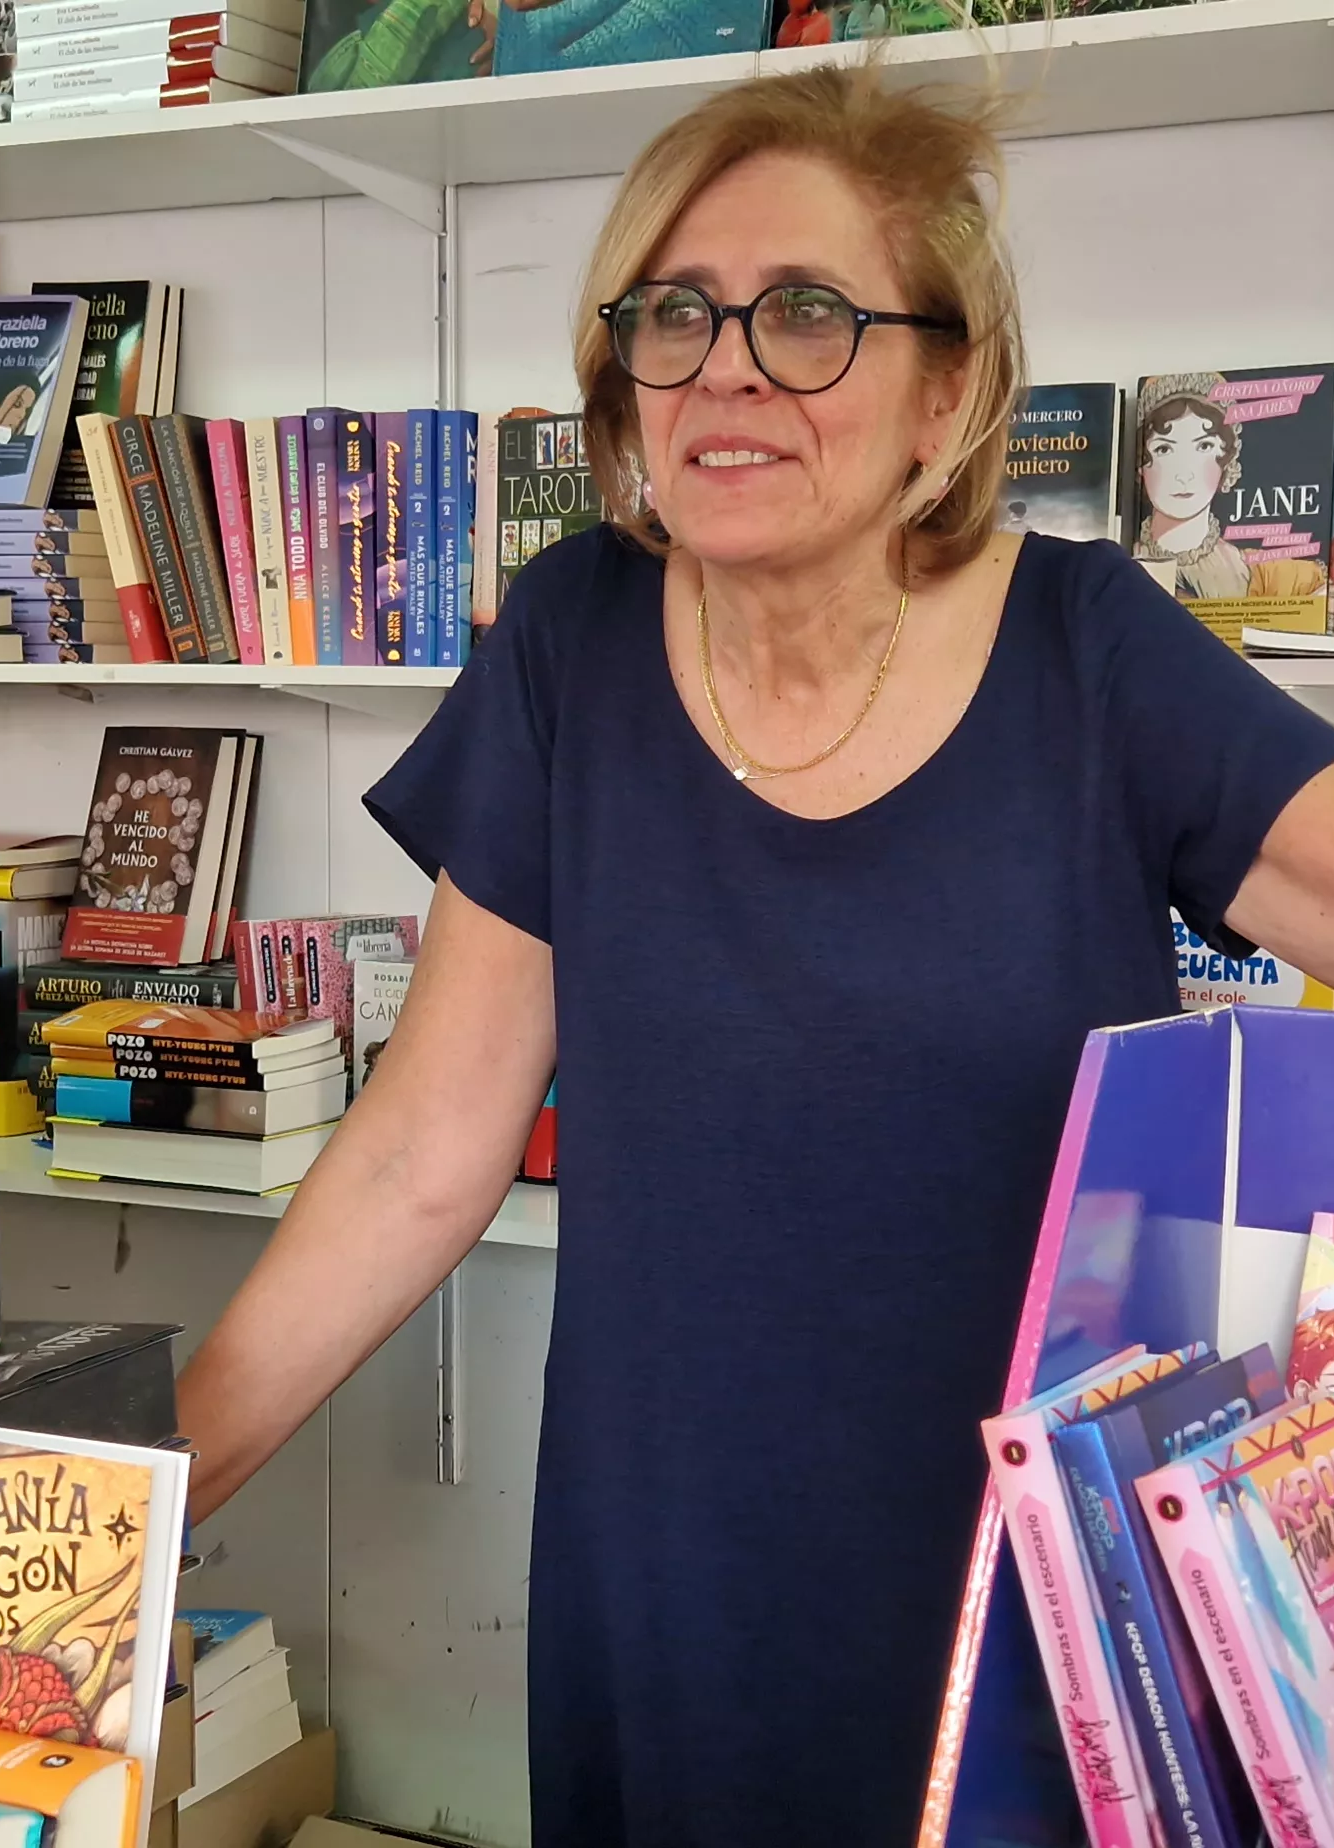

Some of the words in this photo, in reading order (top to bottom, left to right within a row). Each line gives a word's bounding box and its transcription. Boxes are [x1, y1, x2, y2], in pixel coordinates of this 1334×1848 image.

[1021, 409, 1084, 424] MERCERO
[1230, 407, 1256, 420] ANA
[1257, 399, 1295, 418] JARÉN
[504, 431, 526, 460] EL
[1008, 431, 1088, 453] oviendo
[1005, 456, 1070, 479] quiero
[504, 472, 592, 516] TAROT
[1229, 484, 1320, 523] JANE
[123, 426, 145, 474] CIRCE
[137, 483, 170, 566] MADELINE
[160, 570, 185, 626] MILLER
[416, 587, 425, 636] RIVALES
[445, 590, 455, 638] RIVALES
[119, 745, 157, 756] CHRISTIAN
[160, 747, 193, 758] GÁLVEZ
[134, 810, 149, 823] HE
[113, 824, 167, 840] VENCIDO
[128, 840, 144, 852] AL
[110, 853, 158, 868] MUNDO
[1176, 953, 1279, 986] CUENTA
[37, 978, 102, 993] ARTURO
[134, 981, 200, 998] ENVIADO
[1179, 987, 1196, 1001] En
[1200, 988, 1213, 1002] el
[1216, 989, 1247, 1004] cole
[107, 1034, 145, 1048] POZO
[116, 1049, 153, 1062] POZO
[120, 1065, 157, 1079] POZO
[1027, 1512, 1055, 1588] escenario
[1191, 1567, 1228, 1645] escenario
[1058, 1632, 1085, 1702] Sombras
[1237, 1688, 1271, 1760] Sombras
[1138, 1667, 1165, 1731] DEMON
[1156, 1731, 1190, 1807] HUNTERS
